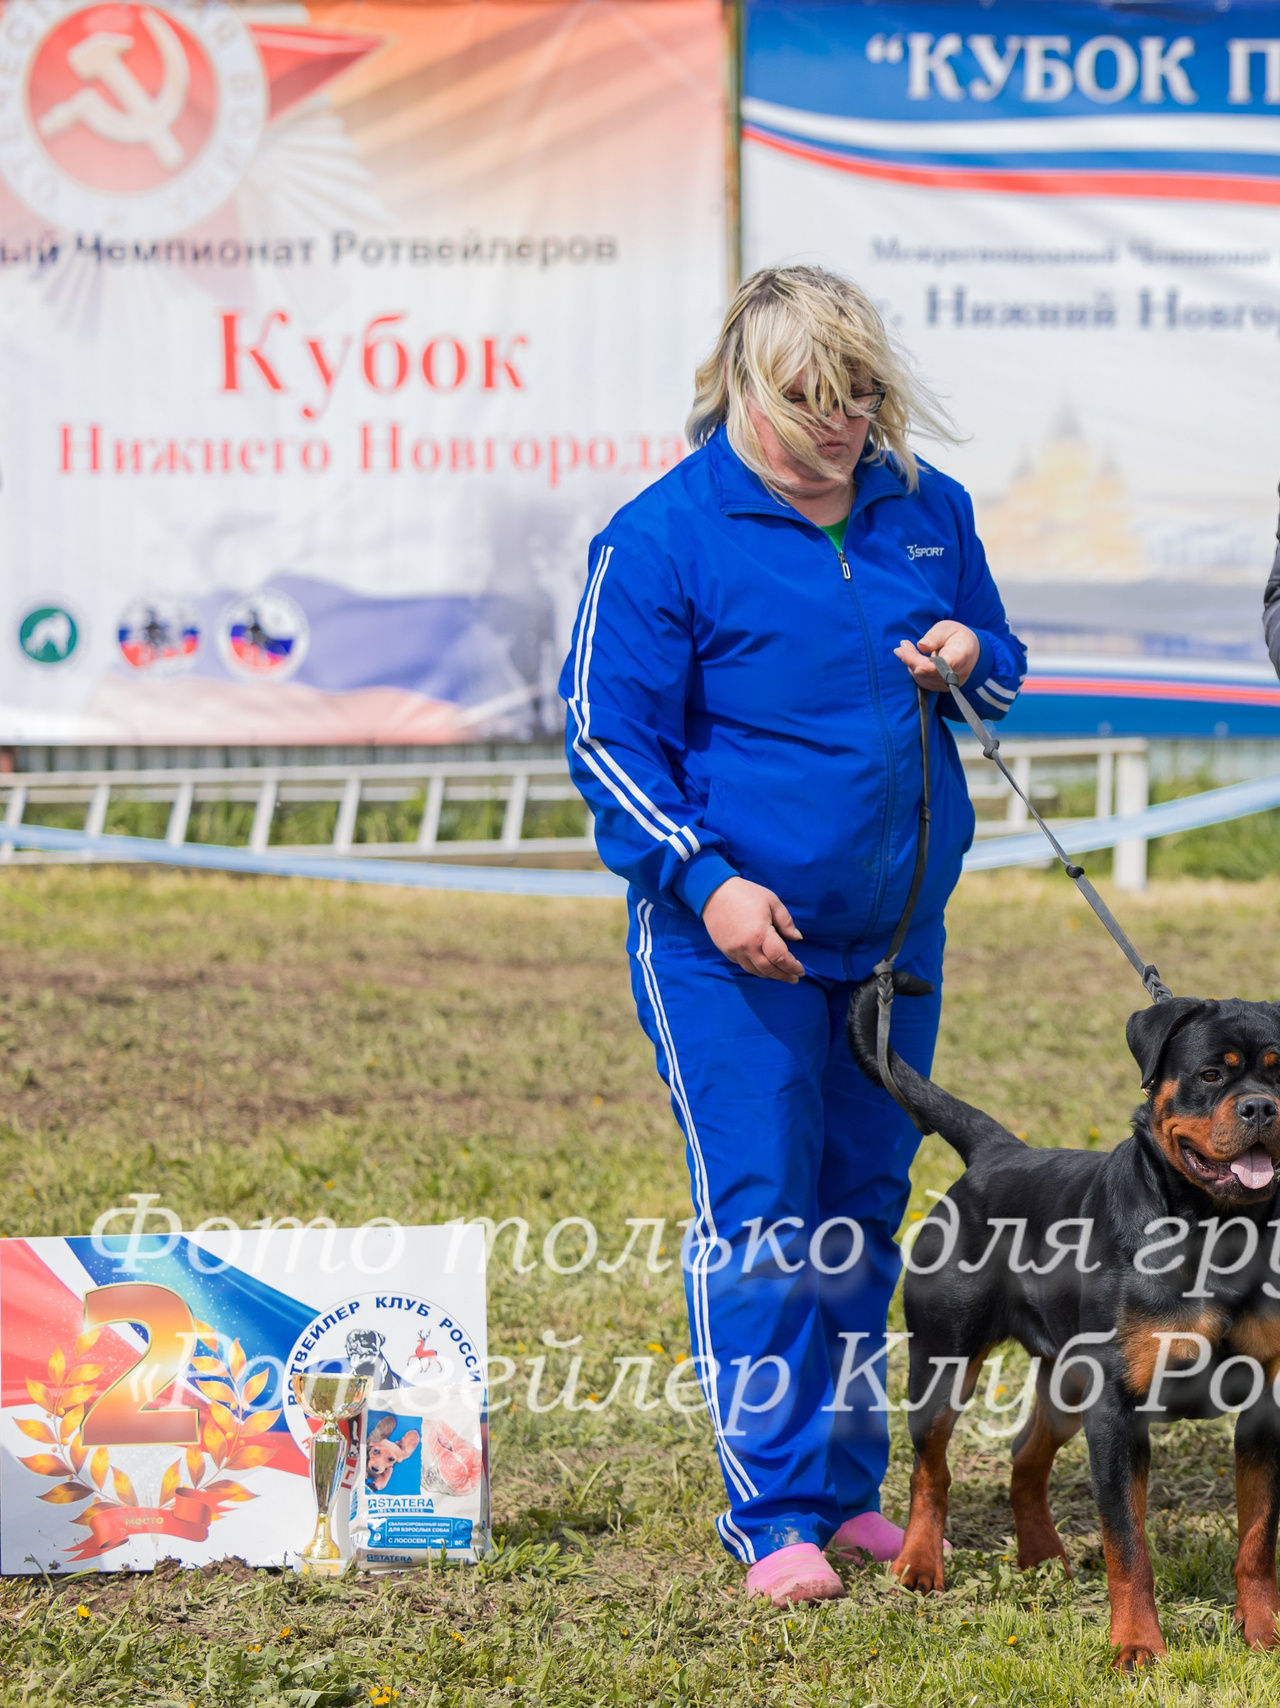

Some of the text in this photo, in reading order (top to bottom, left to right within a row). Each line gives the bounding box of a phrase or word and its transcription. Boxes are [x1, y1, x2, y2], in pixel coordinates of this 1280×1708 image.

[76, 232, 314, 266] Чемпионат
[331, 231, 620, 270] Ротвейлеров
[926, 284, 1117, 329] Нижний
[219, 311, 530, 420] Кубок
[57, 422, 686, 487] Нижнего Новгорода
[80, 1281, 202, 1447] 2
[375, 1296, 431, 1318] КЛУБ
[438, 1317, 482, 1383] РОССИ
[377, 1497, 434, 1508] STATERA
[373, 1554, 413, 1562] STATERA
